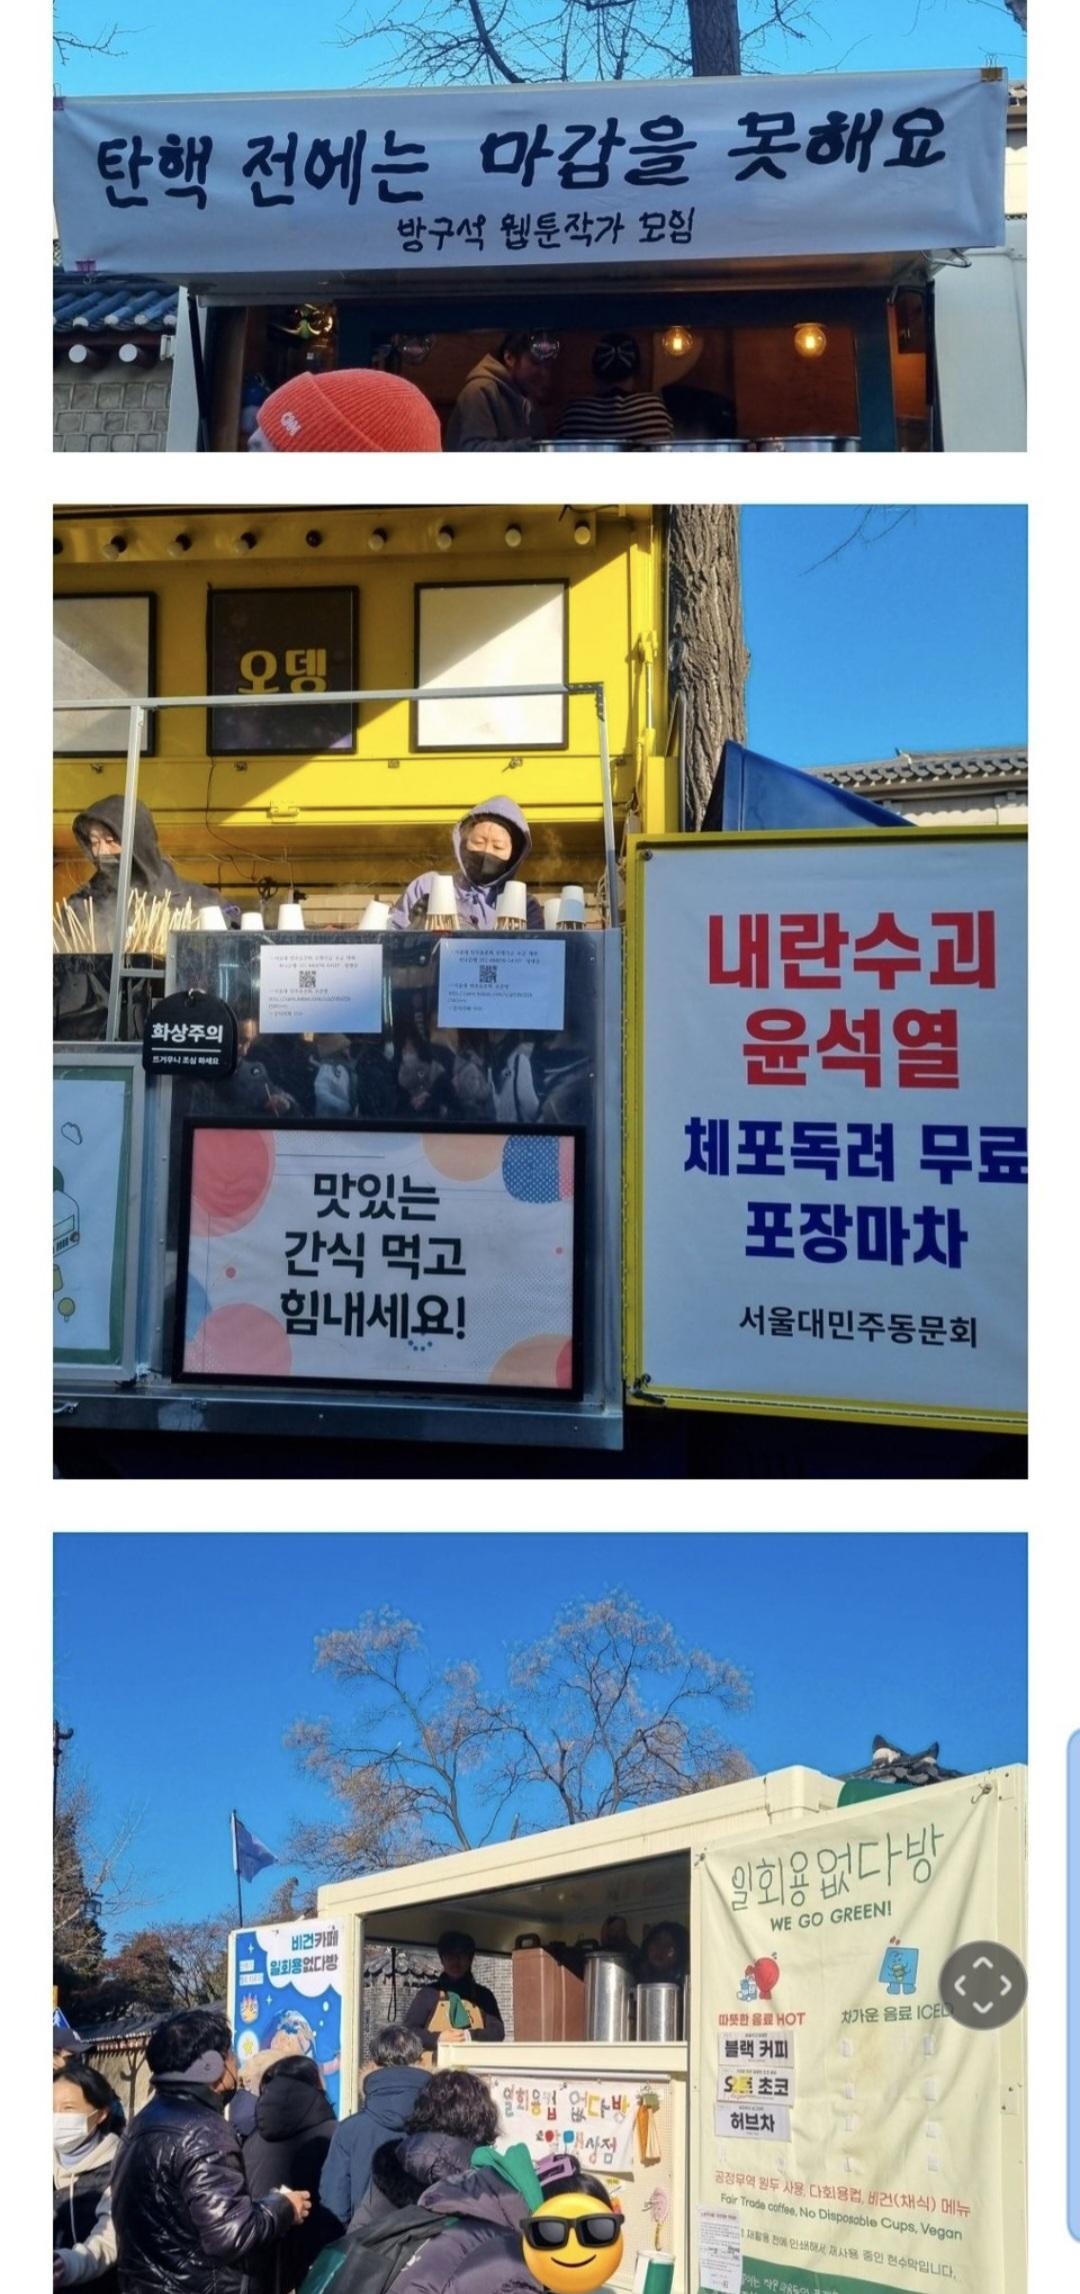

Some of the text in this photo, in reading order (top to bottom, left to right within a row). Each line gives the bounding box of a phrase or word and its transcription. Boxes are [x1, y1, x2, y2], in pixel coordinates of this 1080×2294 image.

[97, 107, 946, 210] 탄핵 전에는 마감을 못해요
[398, 207, 695, 252] 방구석 웹툰작가 모임
[237, 649, 327, 693] 오뎅
[708, 910, 996, 990] 내란수괴
[151, 1023, 223, 1043] 화상주의
[743, 1008, 959, 1089] 윤석열
[684, 1116, 1028, 1185] 체포독려 무료
[314, 1172, 440, 1222] 맛있는
[284, 1230, 467, 1280] 간식 먹고
[745, 1201, 968, 1269] 포장마차
[280, 1289, 466, 1339] 힘내세요!
[739, 1304, 978, 1349] 서울대민주동문회
[770, 1899, 892, 1932] WE GO GREEN!
[270, 1954, 339, 1977] 일회용없다방
[718, 2012, 806, 2027] 따뜻한 음료 HOT
[841, 2007, 879, 2024] 차가운
[884, 2006, 912, 2022] 음료
[725, 2040, 788, 2059] 블랙 커피
[758, 2077, 789, 2096] 초코
[730, 2112, 775, 2133] 허브차
[715, 2170, 755, 2188] 공정무역
[759, 2176, 780, 2191] 원두
[810, 2183, 864, 2206] 다회용컵,
[941, 2198, 971, 2217] 메뉴
[720, 2193, 963, 2241] Fair Trade coffee, No Disposable Cups, Vegan
